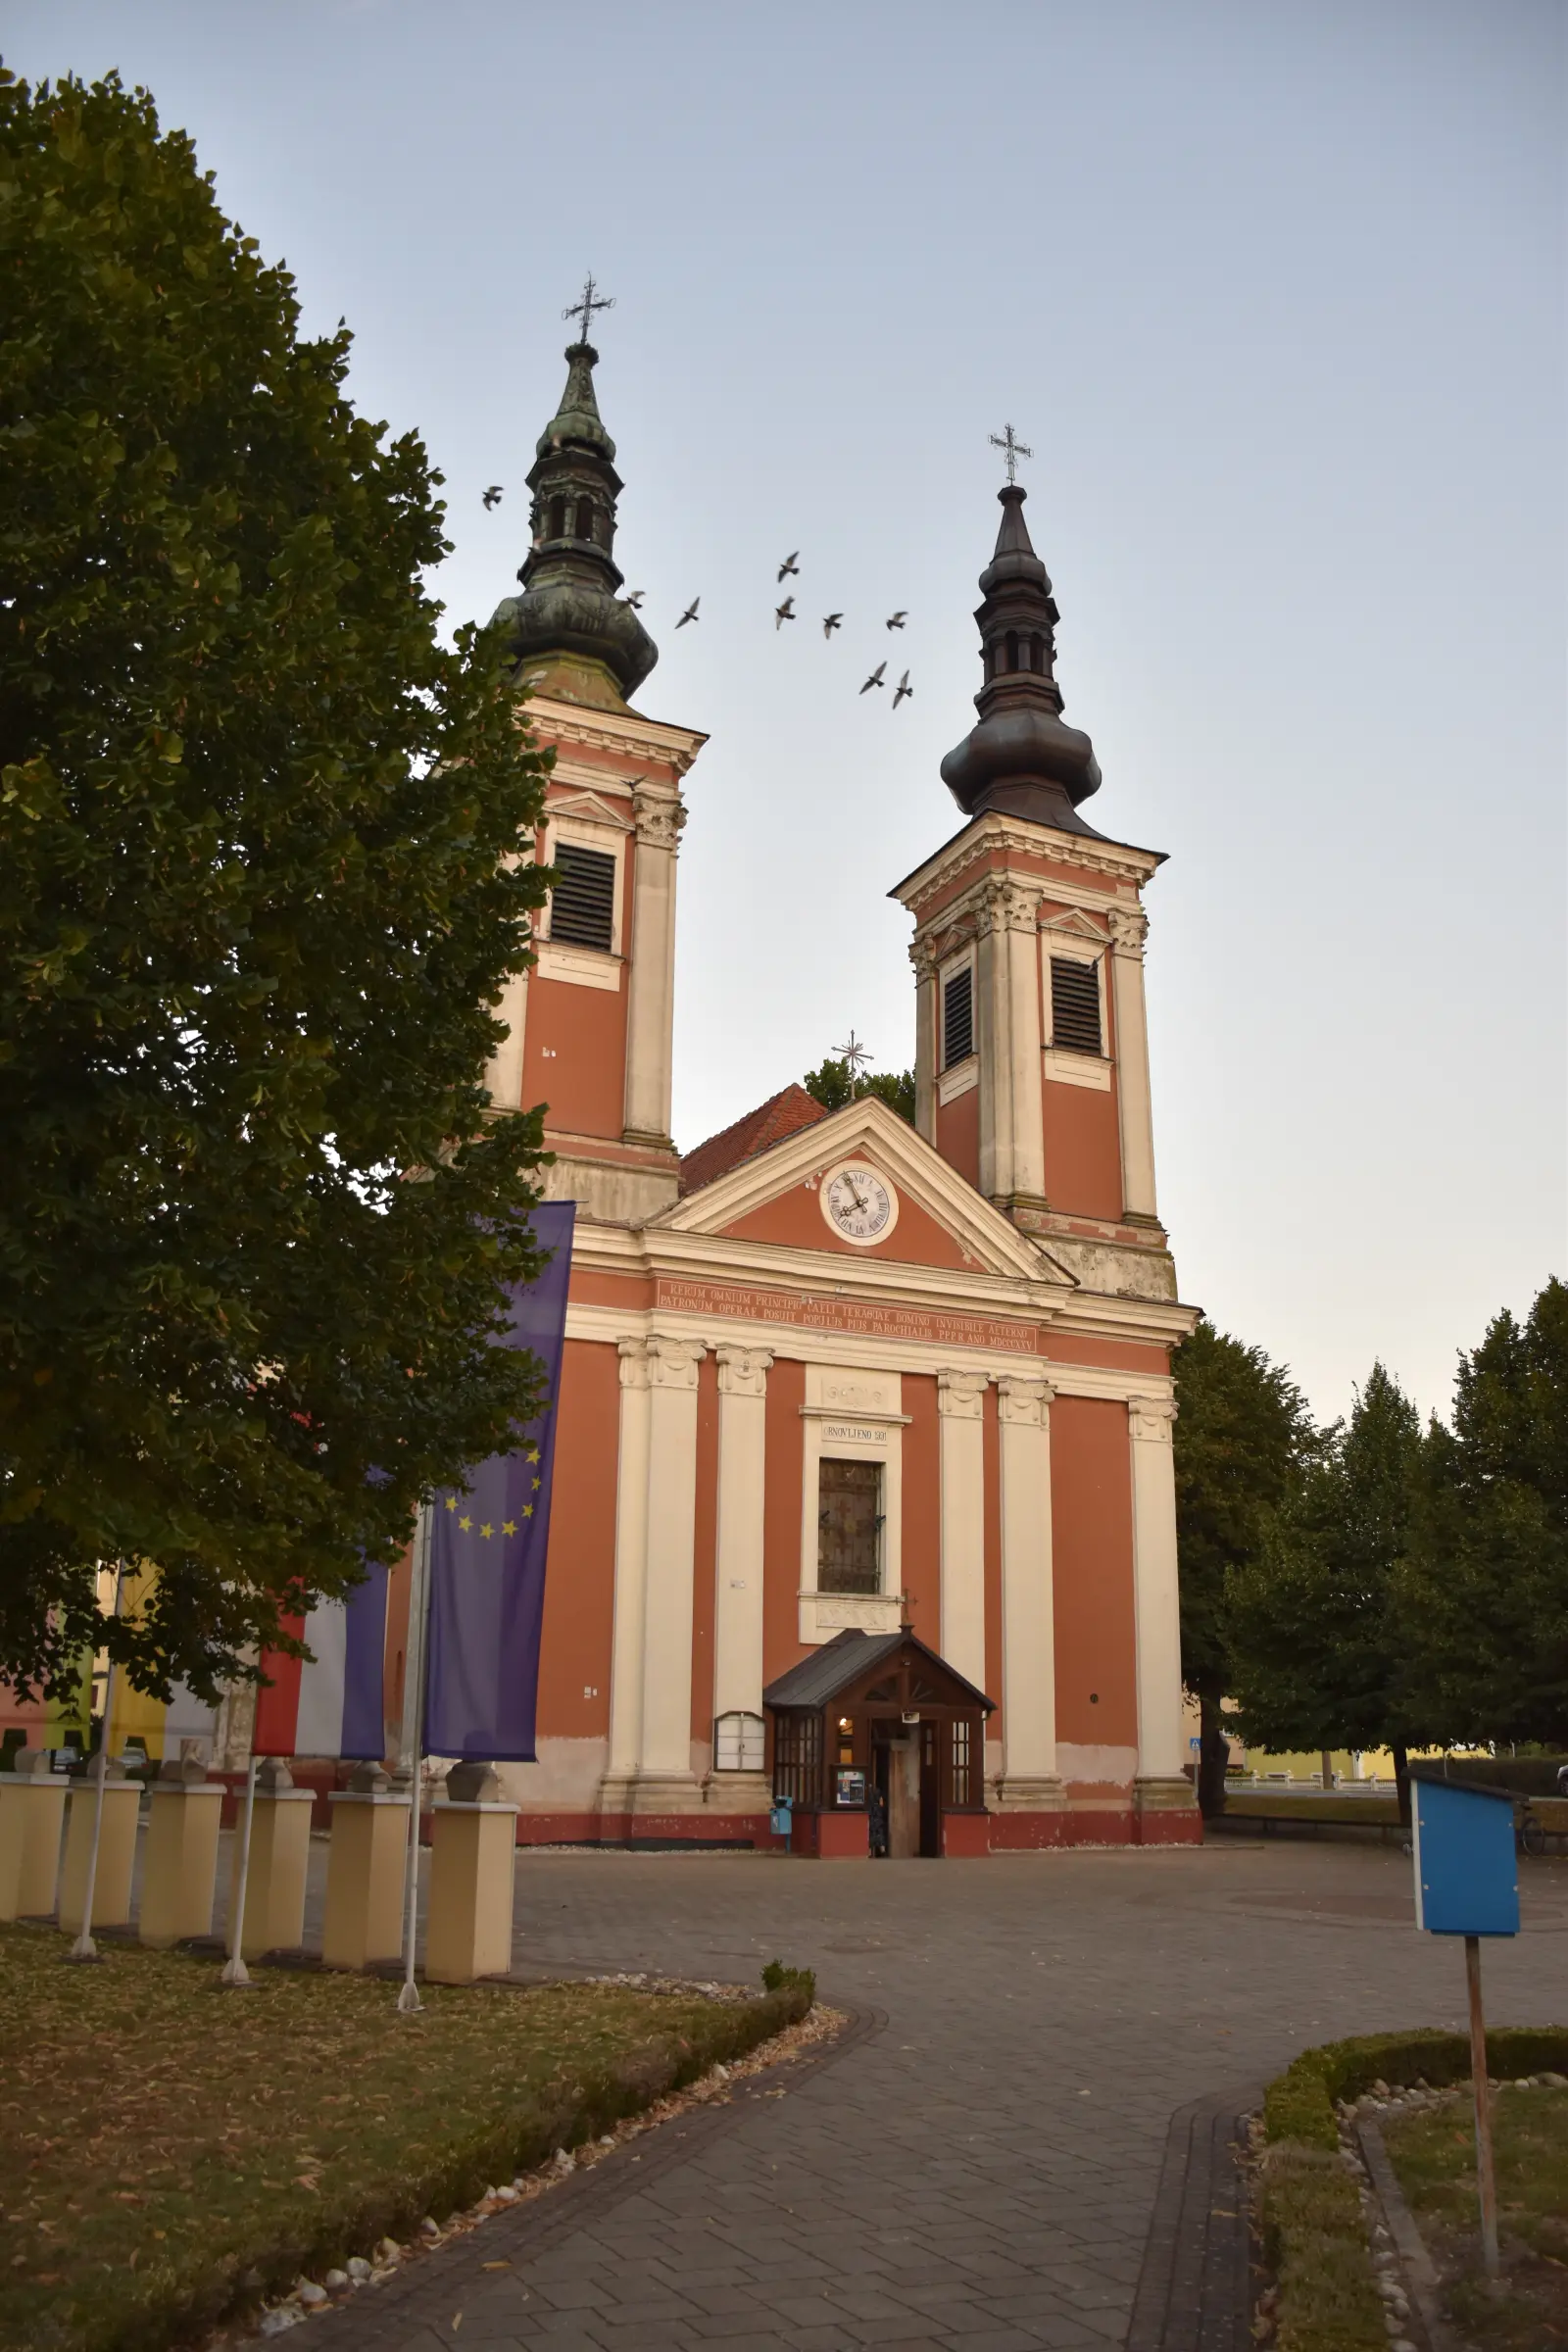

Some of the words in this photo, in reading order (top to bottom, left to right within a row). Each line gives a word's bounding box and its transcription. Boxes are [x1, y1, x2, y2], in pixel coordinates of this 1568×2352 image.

[878, 1202, 888, 1211] III
[660, 1295, 713, 1311] PATRONUM
[718, 1302, 758, 1317] OPERAE
[762, 1307, 796, 1322] POSUIT
[803, 1313, 843, 1327] POPULUS
[848, 1318, 867, 1331] PIUS
[872, 1321, 933, 1339] PAROCHIALIS
[967, 1333, 985, 1345] ANO
[670, 1284, 706, 1298] RERUM
[710, 1290, 751, 1304] OMNIUM
[896, 1312, 930, 1326] DOMINO
[936, 1317, 985, 1333] INVISIBILE
[988, 1324, 1028, 1338] AETERNO
